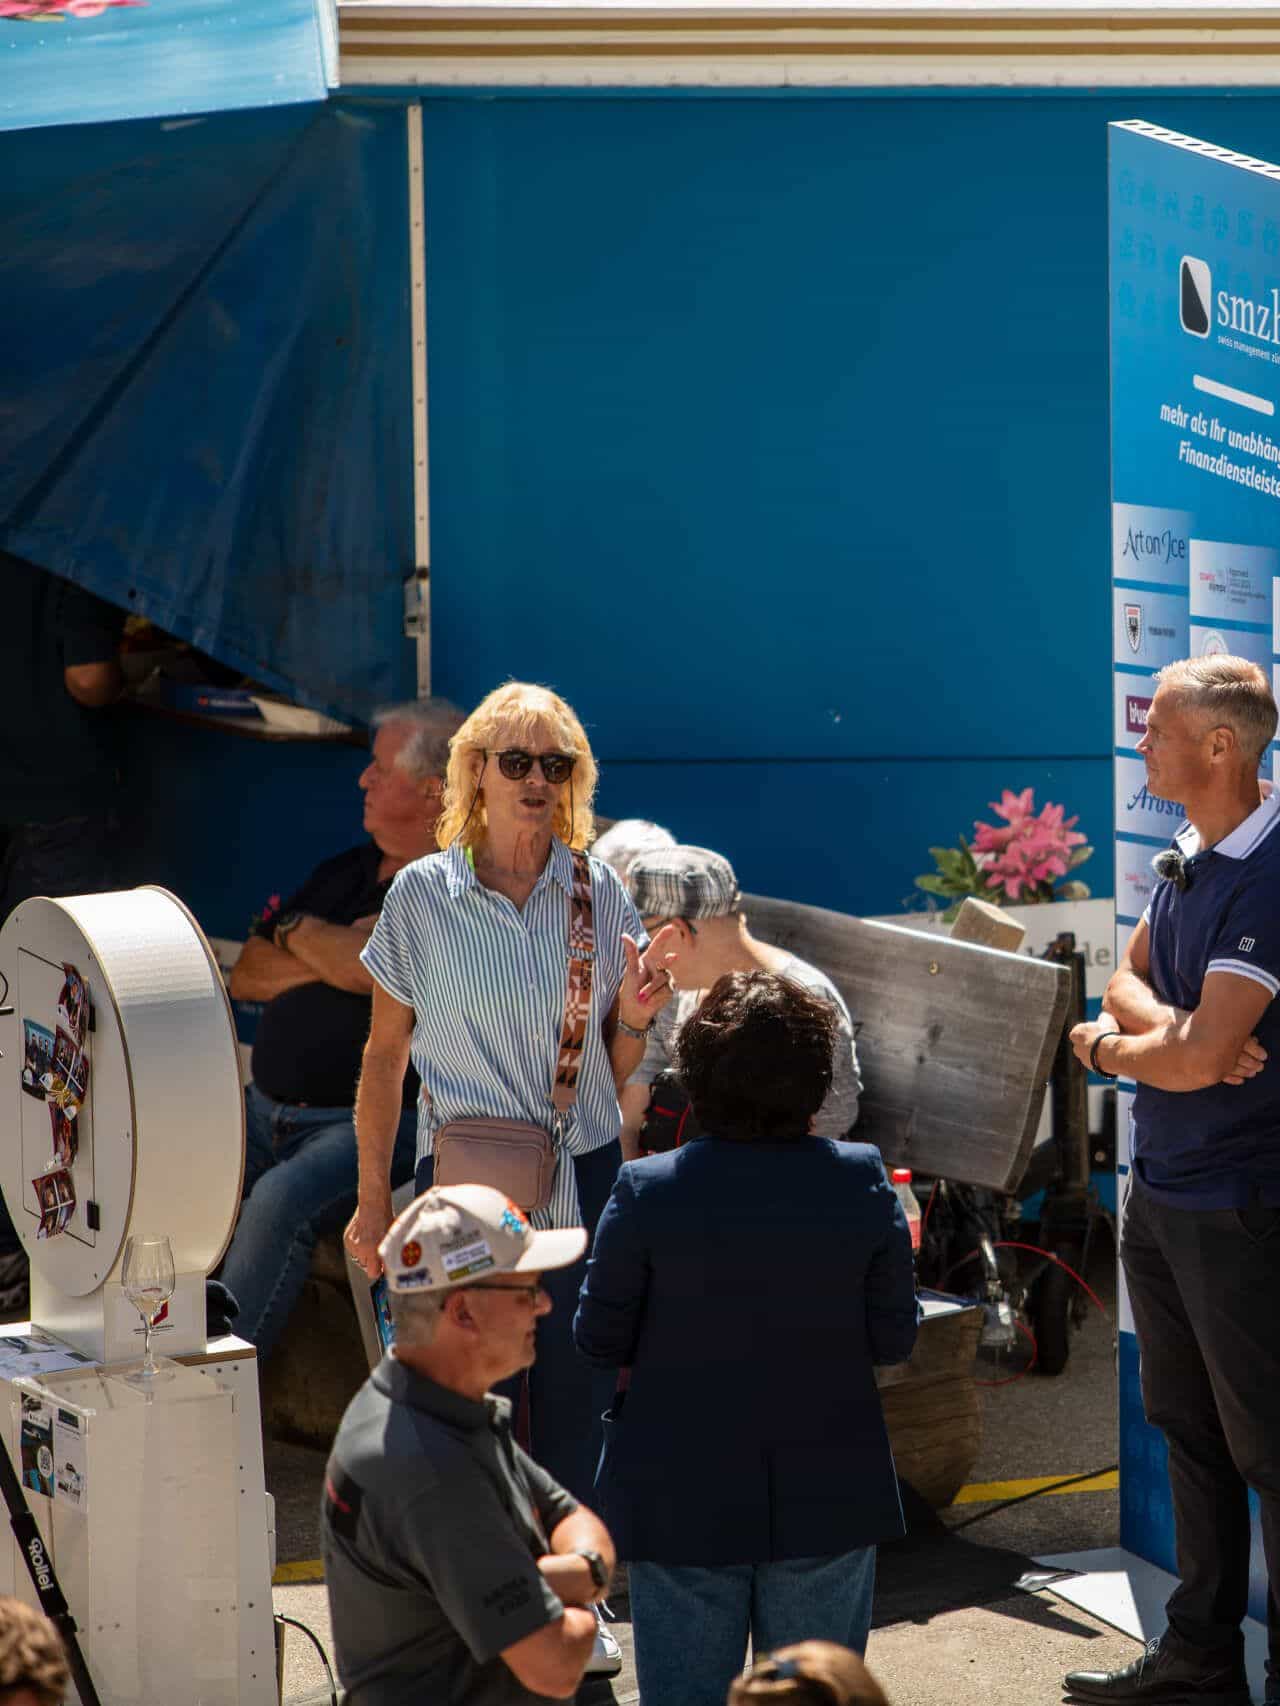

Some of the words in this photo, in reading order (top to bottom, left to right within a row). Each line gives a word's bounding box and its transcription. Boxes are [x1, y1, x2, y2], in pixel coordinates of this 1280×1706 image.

[1160, 404, 1189, 428] mehr
[1190, 412, 1208, 436] als
[1210, 418, 1226, 443] Ihr
